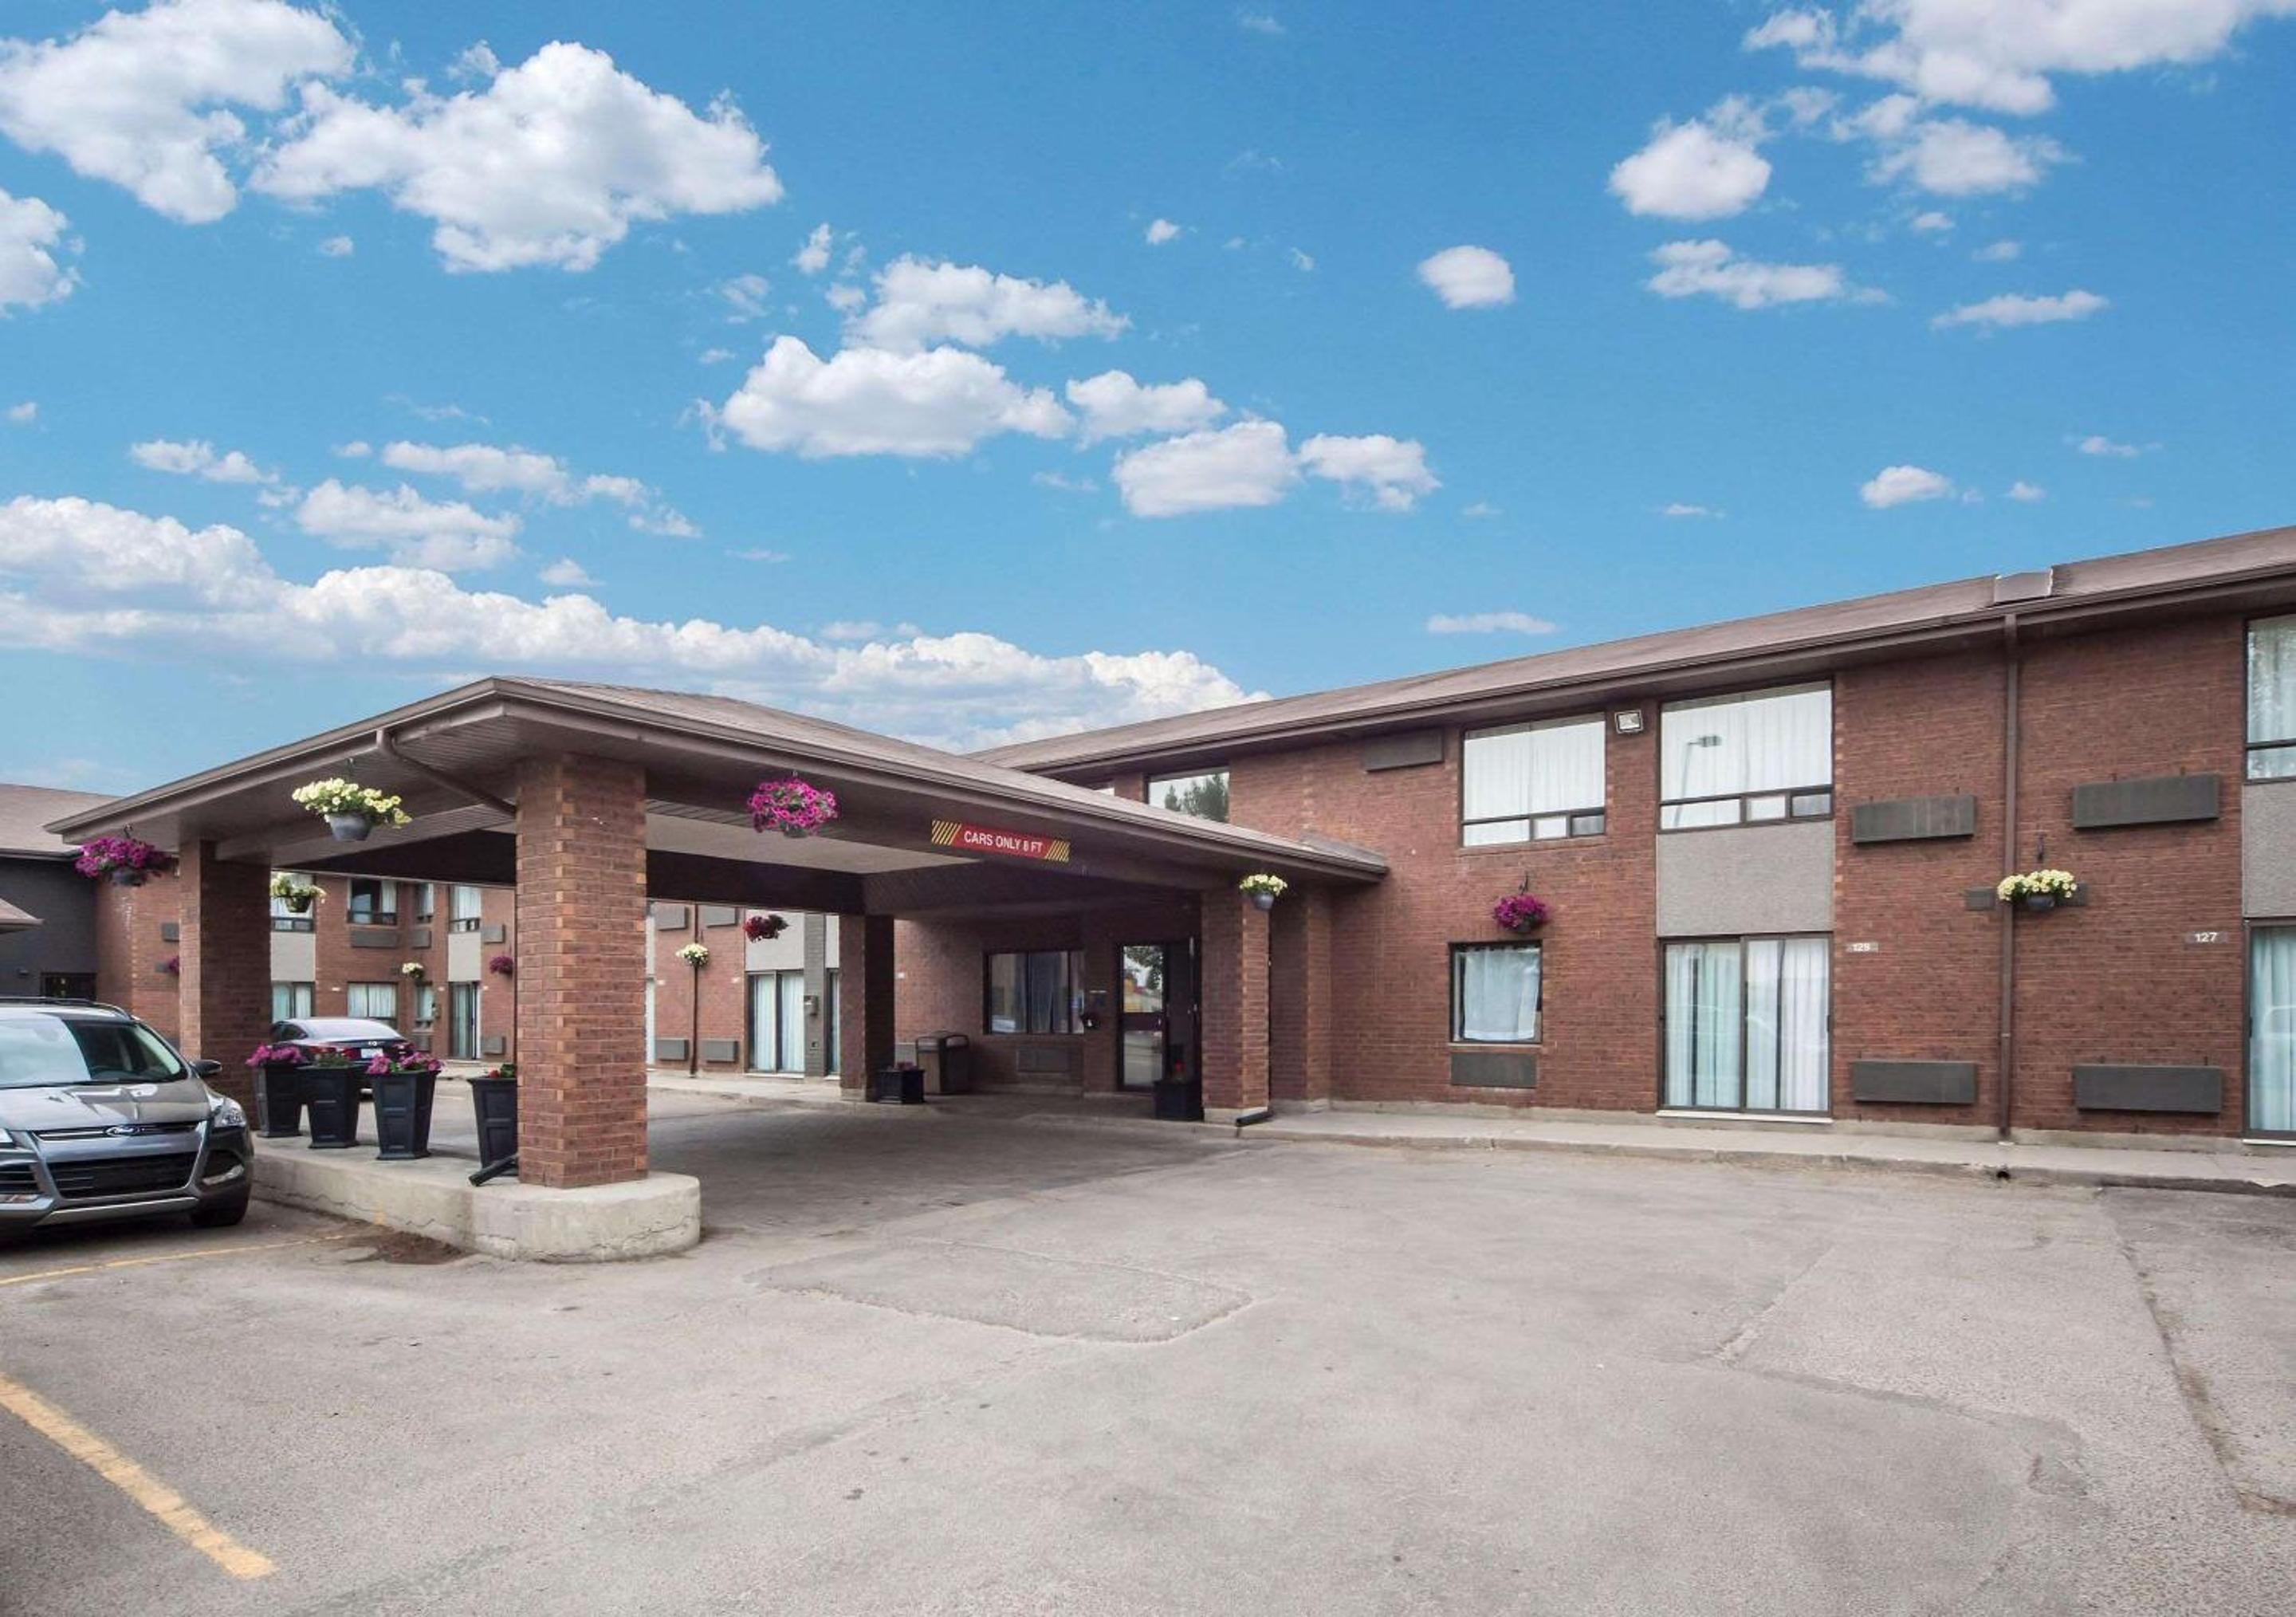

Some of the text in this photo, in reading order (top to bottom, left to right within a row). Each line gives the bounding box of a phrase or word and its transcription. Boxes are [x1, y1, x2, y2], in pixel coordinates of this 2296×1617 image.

[964, 831, 993, 846] CARS
[996, 836, 1020, 850] ONLY
[1031, 841, 1043, 853] FT
[2194, 932, 2218, 942] 127
